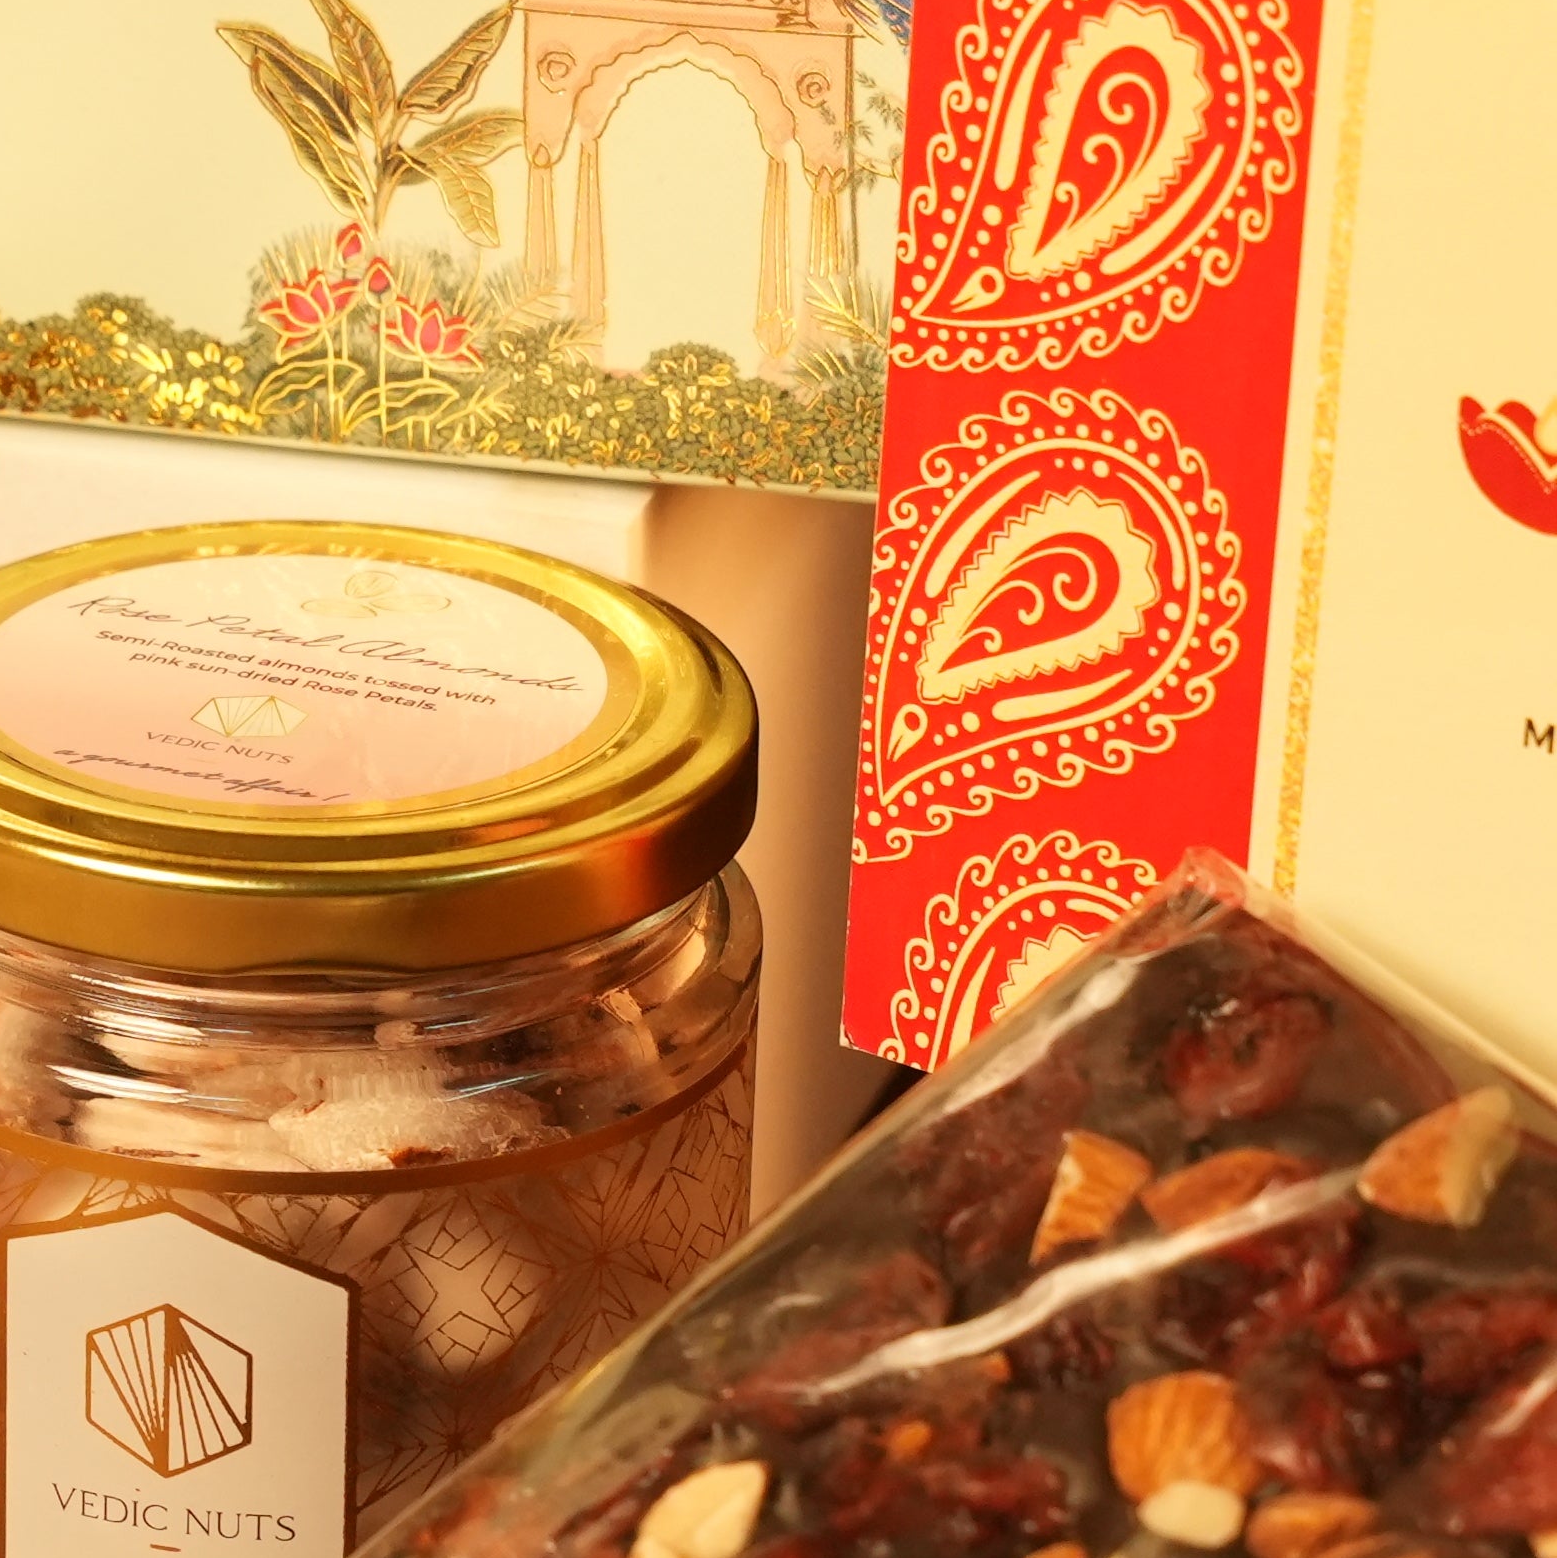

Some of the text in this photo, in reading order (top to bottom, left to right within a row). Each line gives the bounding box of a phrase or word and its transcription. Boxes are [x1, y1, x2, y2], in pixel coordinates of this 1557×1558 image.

[67, 595, 584, 691] Rose Petal Almonds
[95, 630, 497, 706] Semi-Roasted almonds tossed with
[129, 652, 438, 711] pink sun-dried Rose Petals.
[53, 748, 79, 756] a
[67, 753, 225, 781] gourmet
[146, 731, 294, 765] VEDIC NUTS
[52, 1483, 297, 1543] VEDIC NUTS
